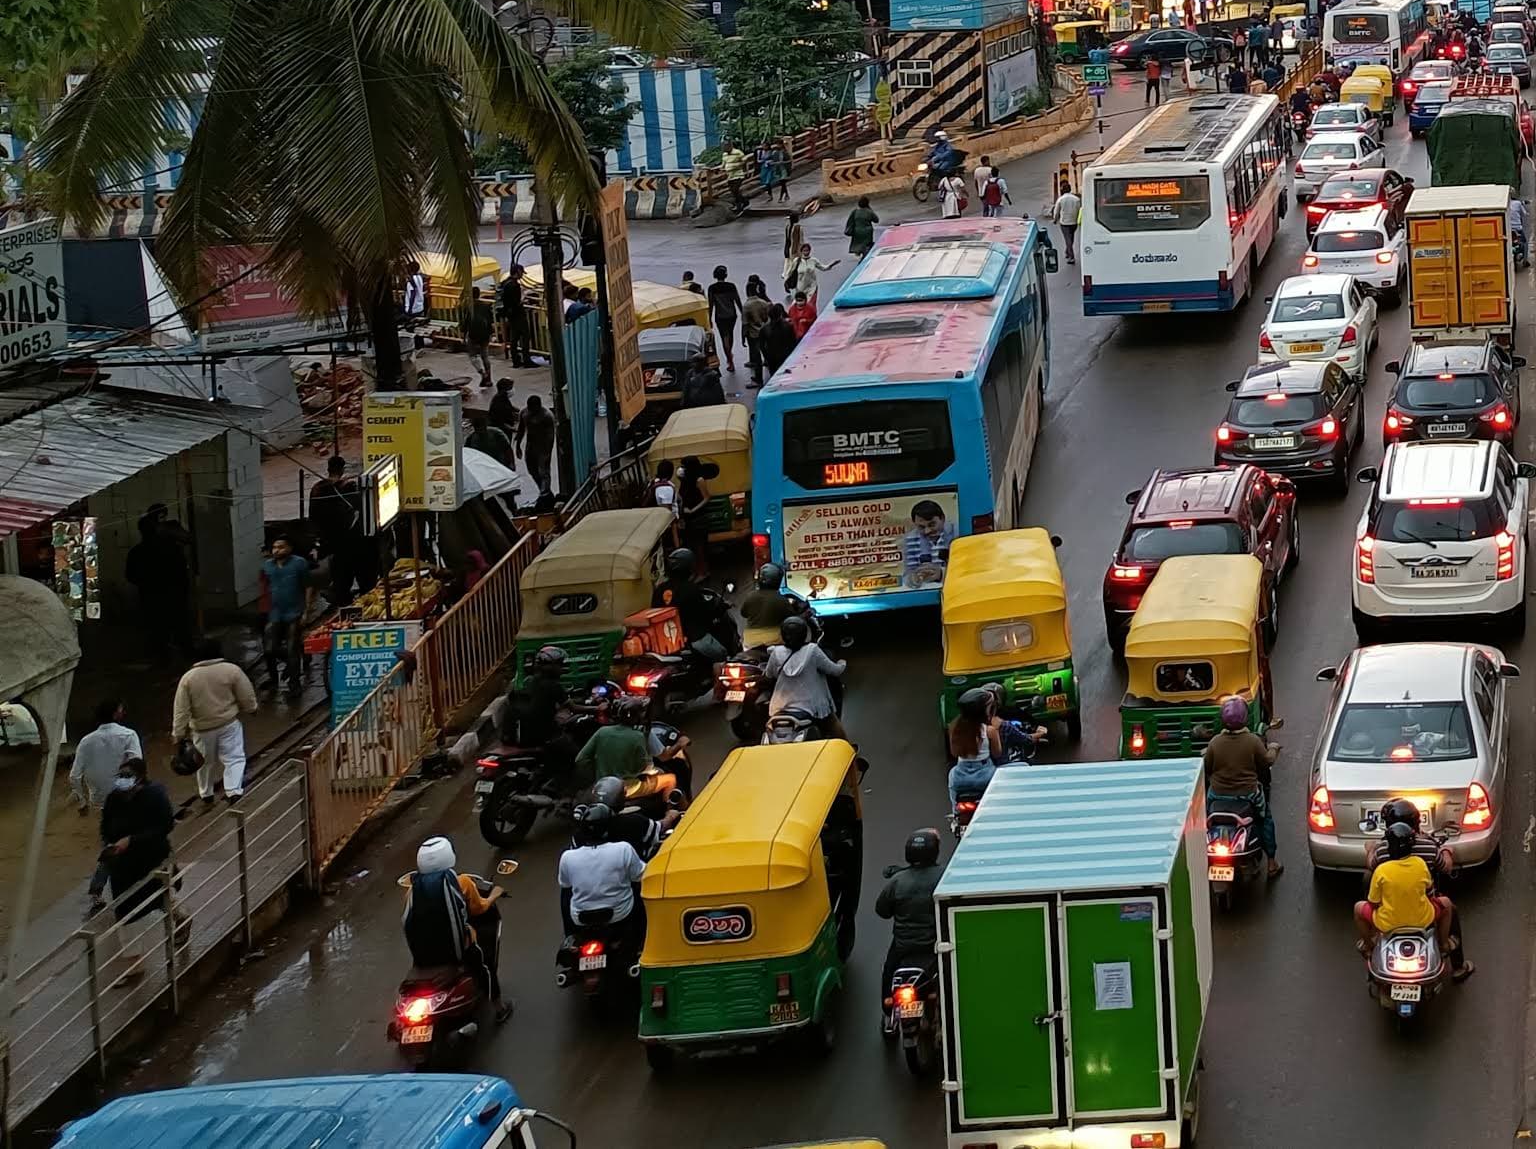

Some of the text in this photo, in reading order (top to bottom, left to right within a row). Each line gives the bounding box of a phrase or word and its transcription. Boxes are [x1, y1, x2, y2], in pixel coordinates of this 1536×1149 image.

[367, 417, 406, 425] CEMENT
[833, 430, 900, 447] BMTC
[816, 503, 891, 518] SELLING GOLD
[827, 516, 882, 529] IS ALWAYS
[804, 526, 905, 544] BETTER THAN LOAN
[790, 561, 818, 571] CALL
[857, 555, 878, 563] 300
[881, 552, 901, 562] 300
[336, 632, 400, 650] FREE
[345, 661, 392, 679] EYE
[345, 678, 392, 687] TESTIN
